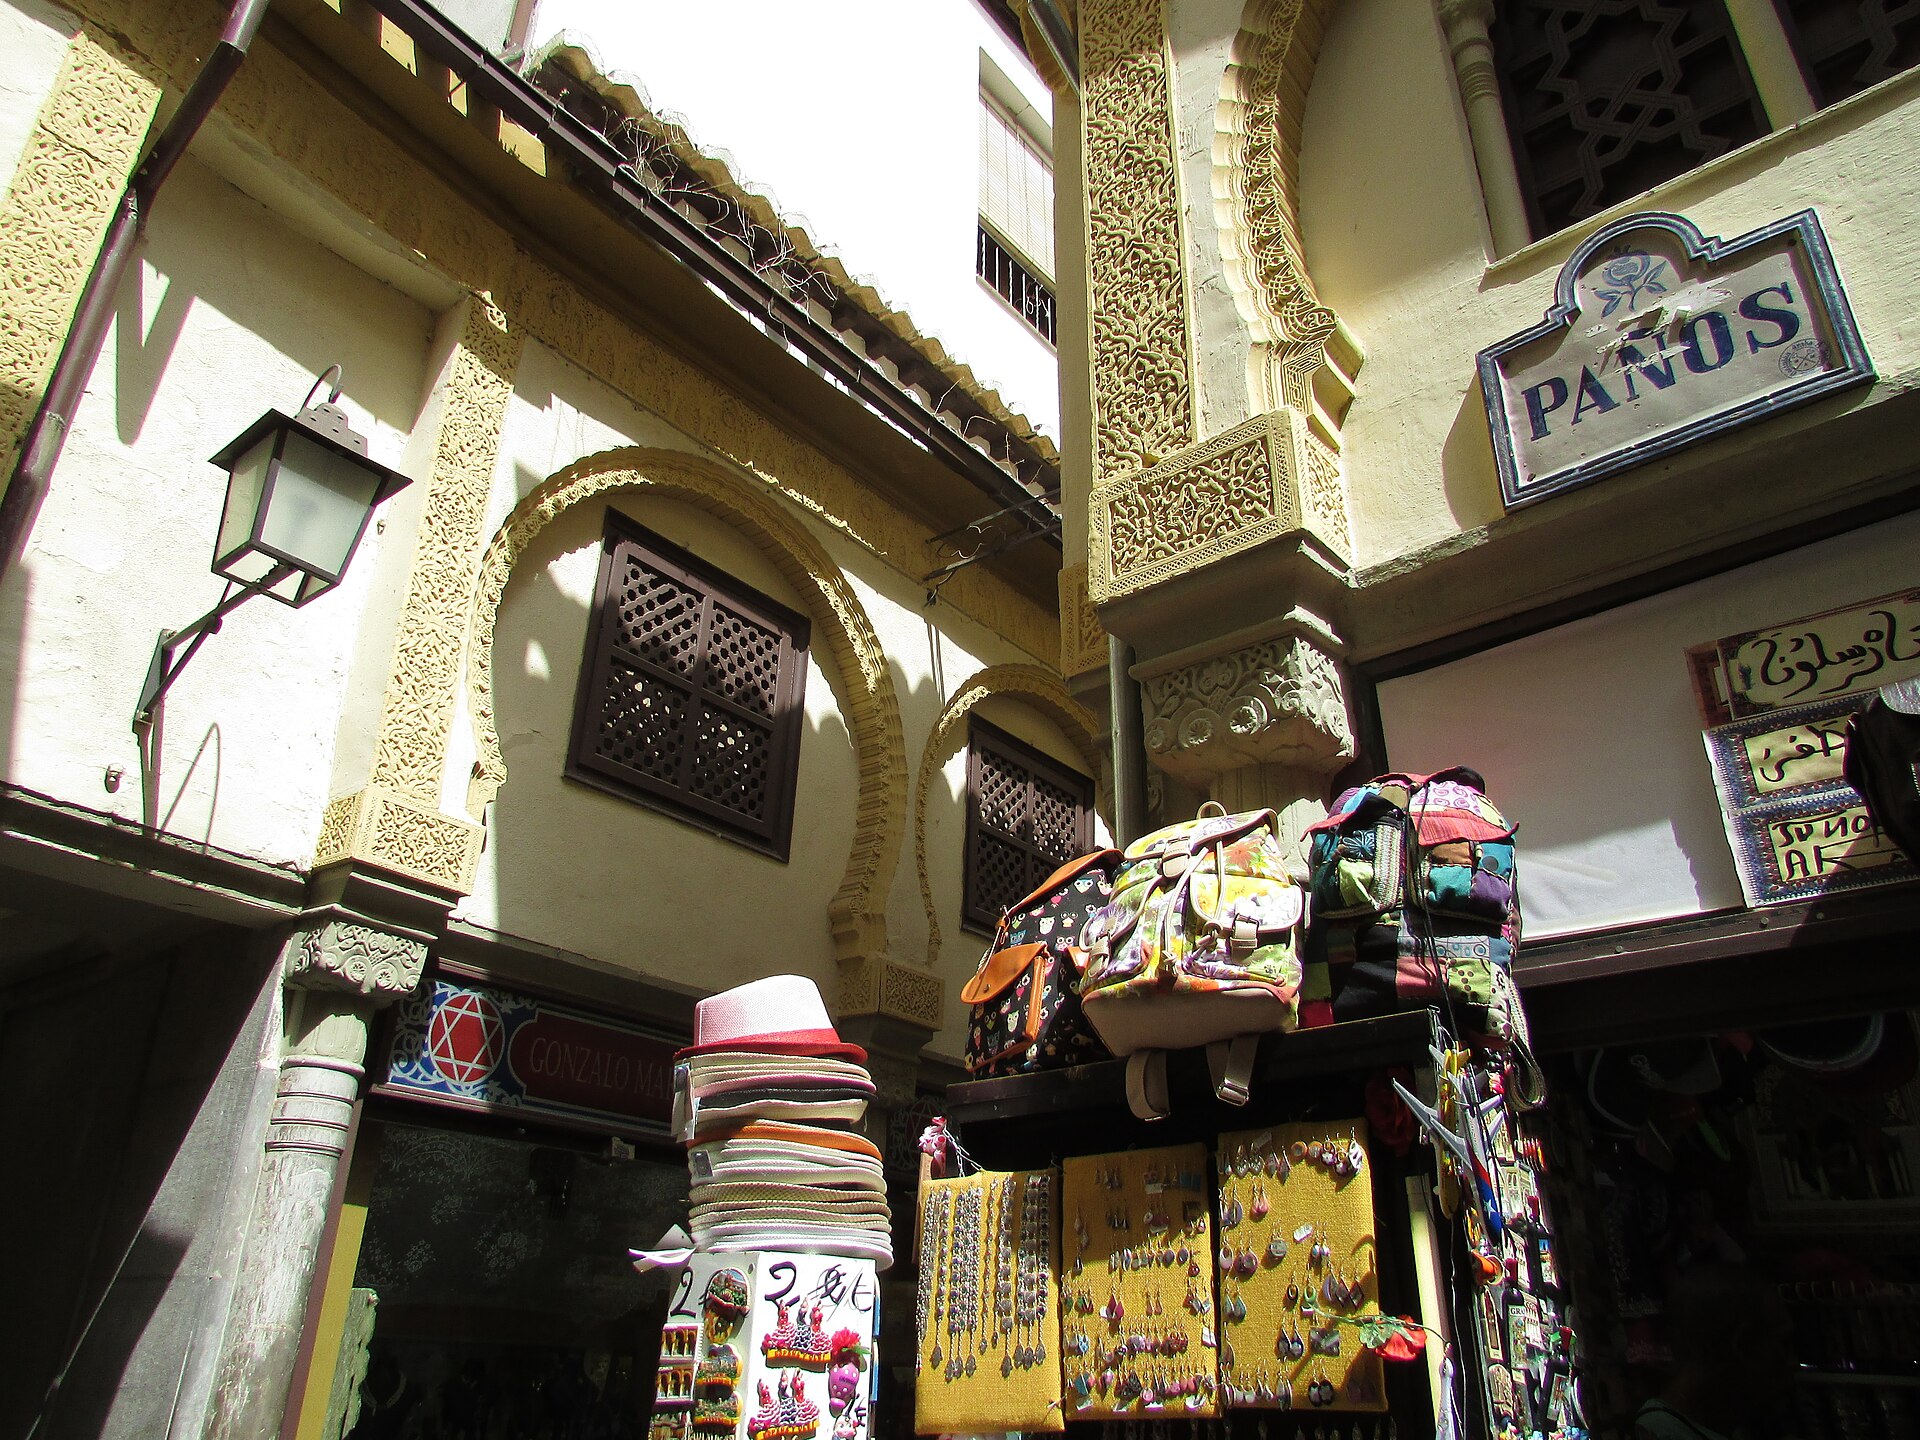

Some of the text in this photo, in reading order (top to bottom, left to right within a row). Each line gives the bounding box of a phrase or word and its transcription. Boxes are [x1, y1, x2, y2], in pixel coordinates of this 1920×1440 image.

[1521, 282, 1800, 441] PAÑOS
[529, 1037, 630, 1090] GONZALO
[670, 1266, 696, 1318] 2
[764, 1261, 800, 1309] 2
